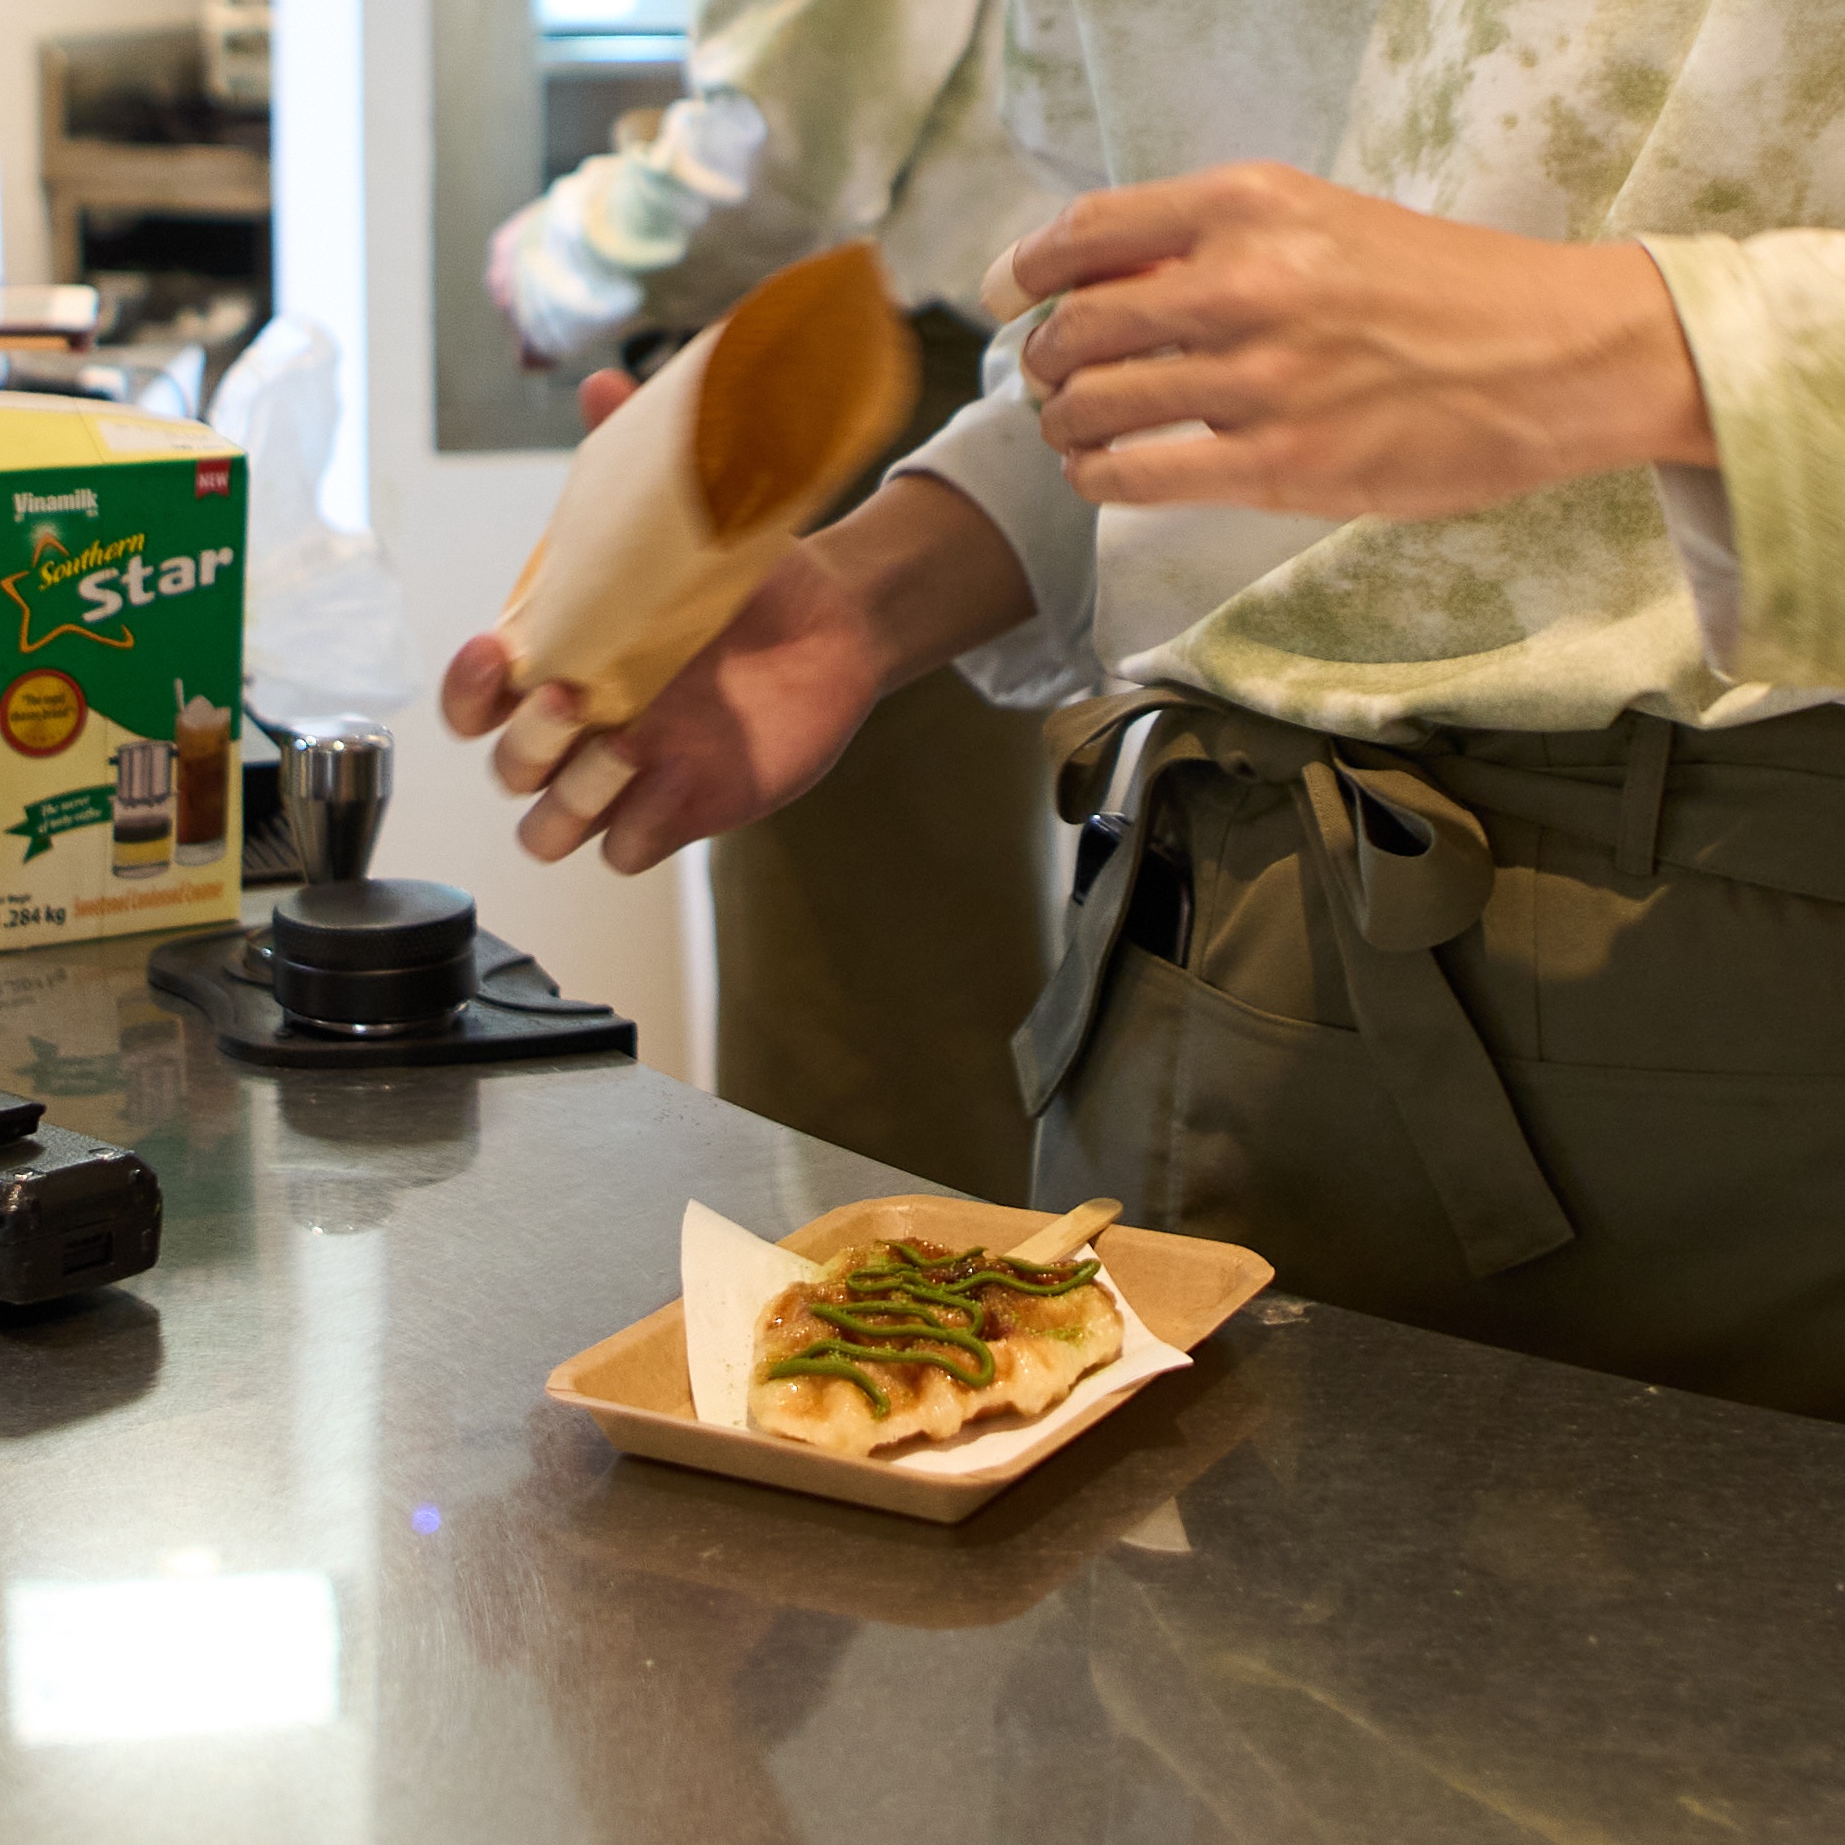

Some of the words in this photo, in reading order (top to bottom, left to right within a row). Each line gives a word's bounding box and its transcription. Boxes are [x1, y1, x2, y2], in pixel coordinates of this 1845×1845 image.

[198, 472, 230, 489] NEW
[13, 488, 98, 520] Vinamilk
[38, 533, 145, 591] Southern
[78, 547, 234, 623] Star
[44, 904, 67, 926] kg
